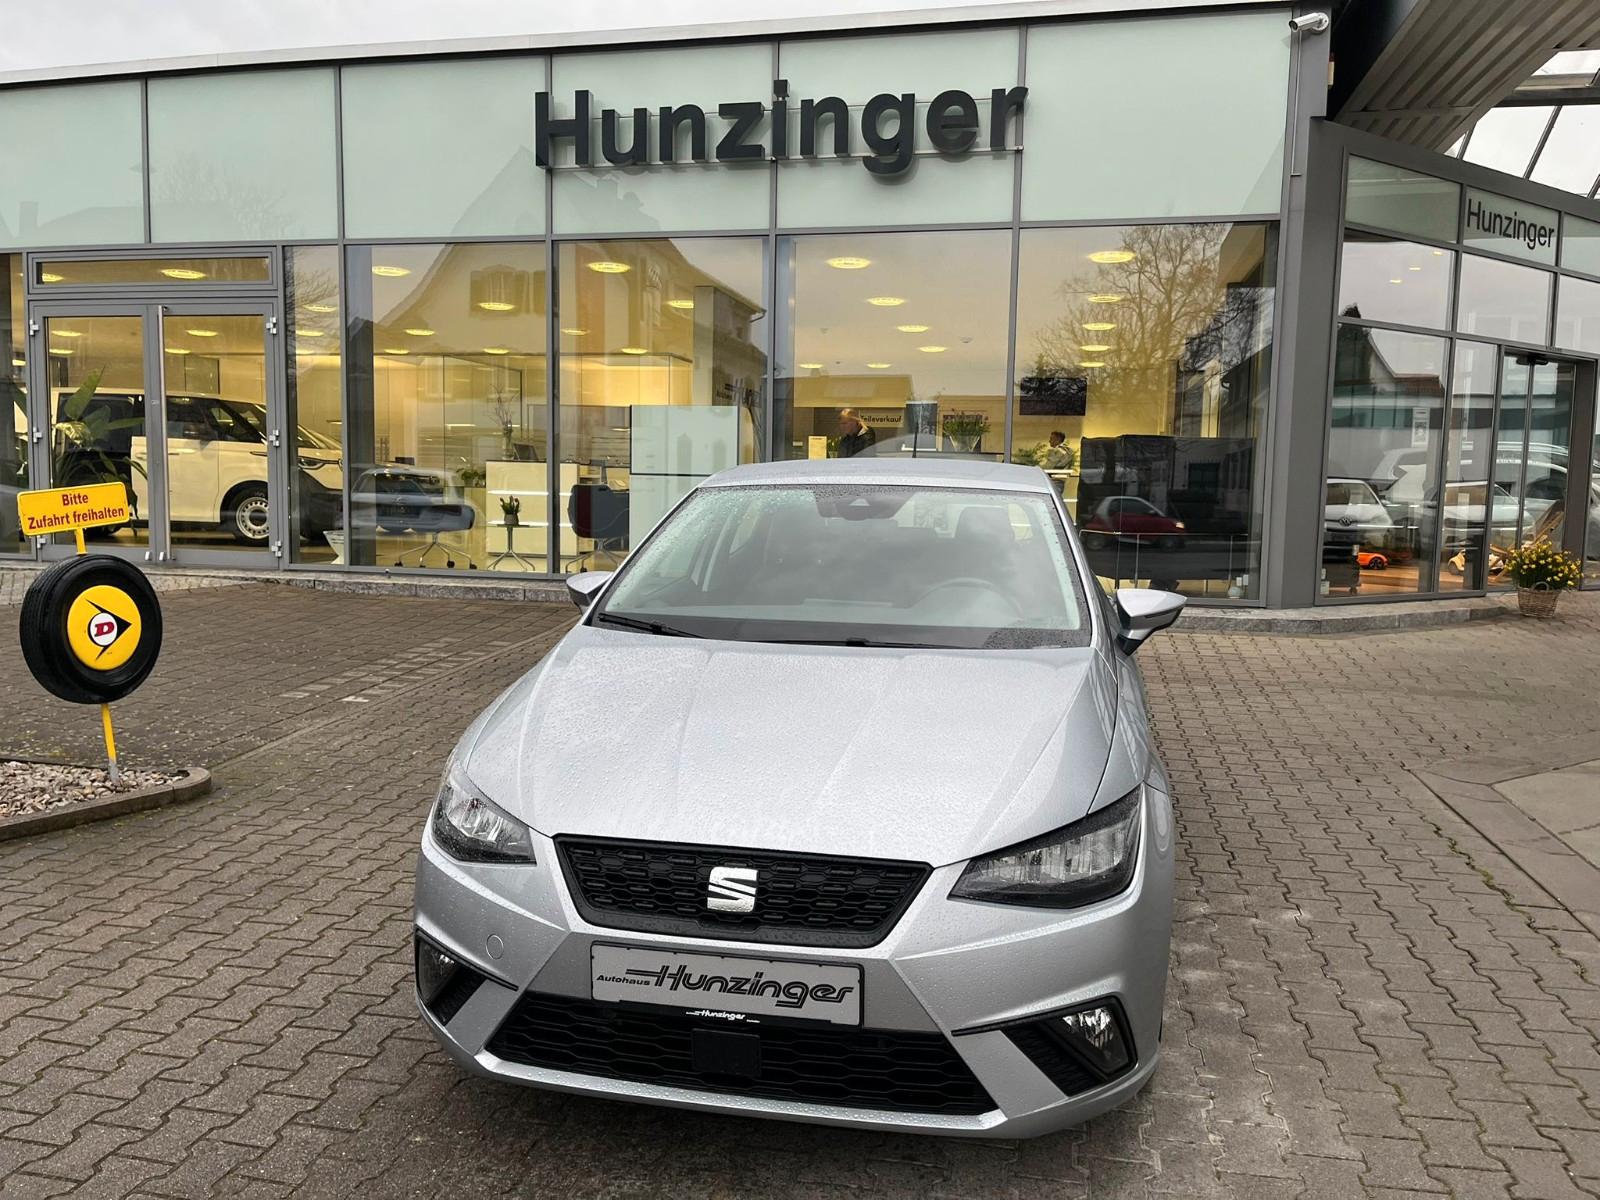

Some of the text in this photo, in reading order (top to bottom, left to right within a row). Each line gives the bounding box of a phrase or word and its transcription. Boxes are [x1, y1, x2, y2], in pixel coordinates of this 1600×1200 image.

[535, 79, 1029, 179] Hunzinger
[1467, 199, 1554, 250] Hunzinger
[61, 493, 88, 506] Bitte
[28, 507, 124, 530] Zufahrt freihalten
[94, 621, 115, 637] D
[596, 964, 854, 1009] Autohaus Hunzinger
[700, 1009, 746, 1021] Hunzinger
